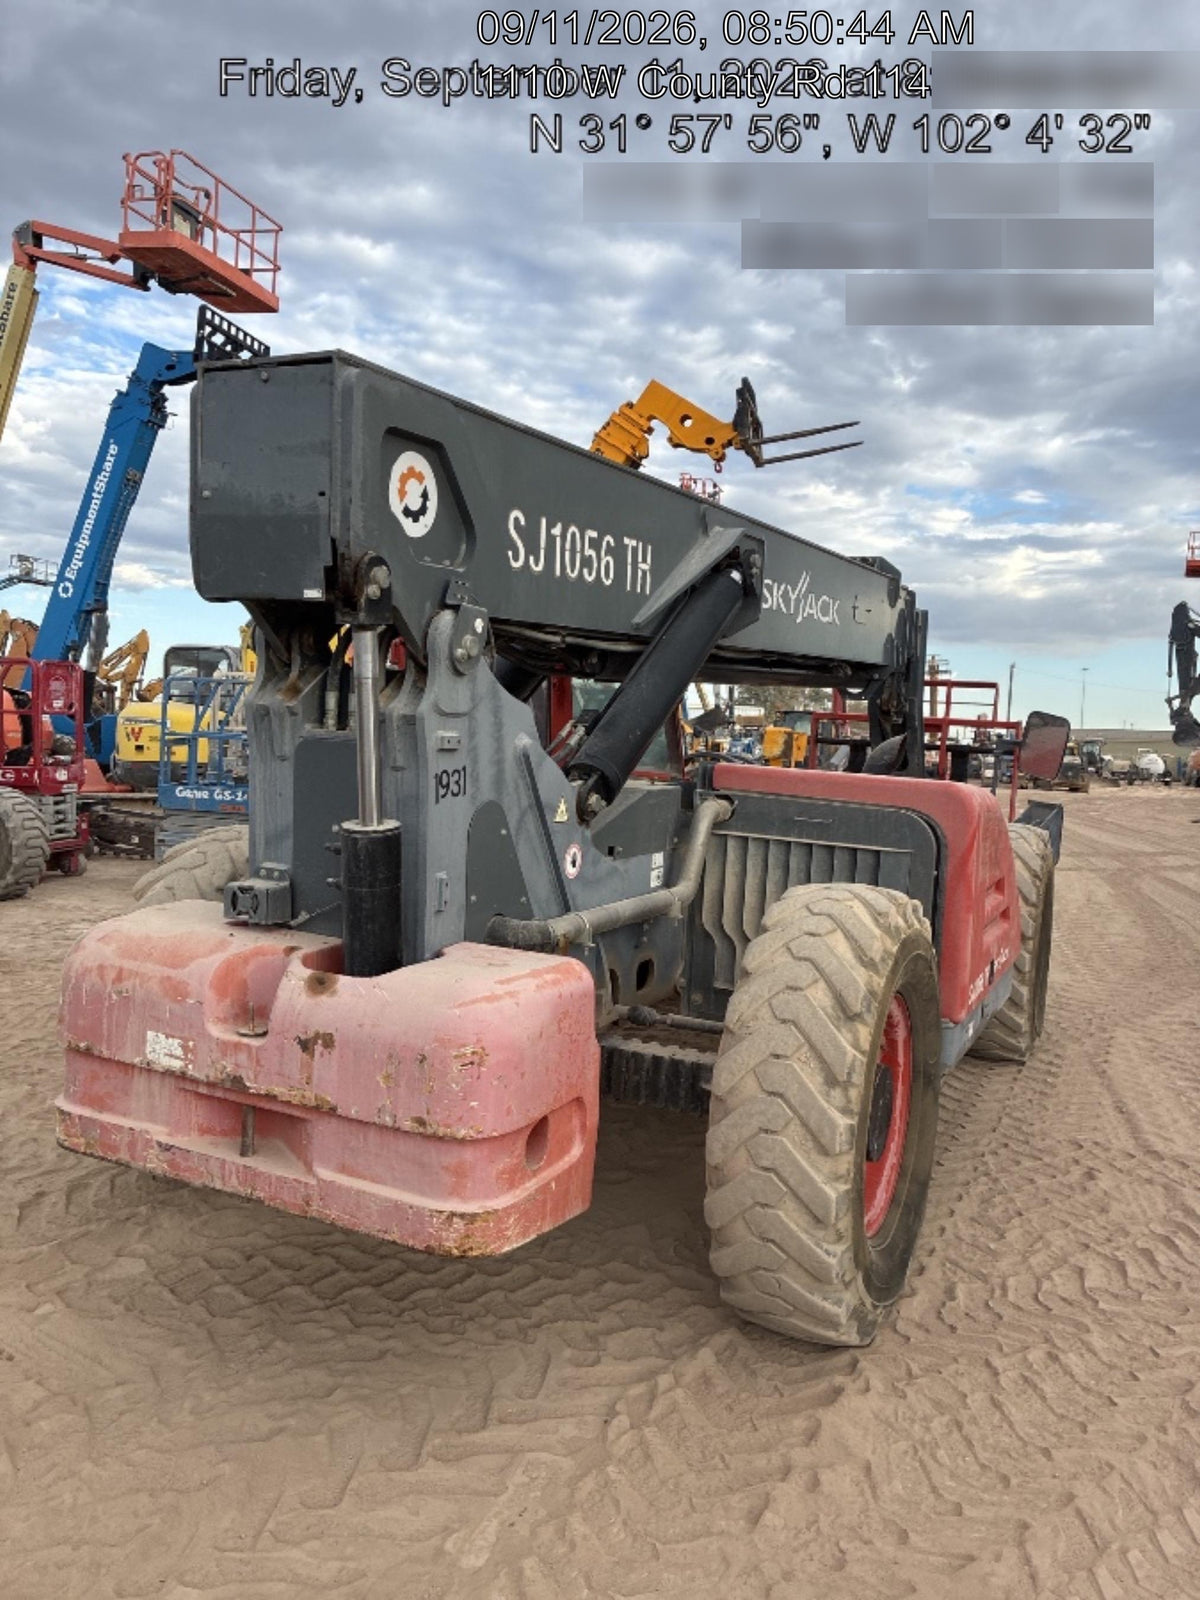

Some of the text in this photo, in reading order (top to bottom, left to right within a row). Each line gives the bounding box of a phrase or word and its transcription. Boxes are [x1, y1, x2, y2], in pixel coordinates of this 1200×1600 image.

[65, 443, 118, 580] EquipmentShare
[508, 509, 652, 595] SJ1056 TH
[434, 765, 467, 804] 1931
